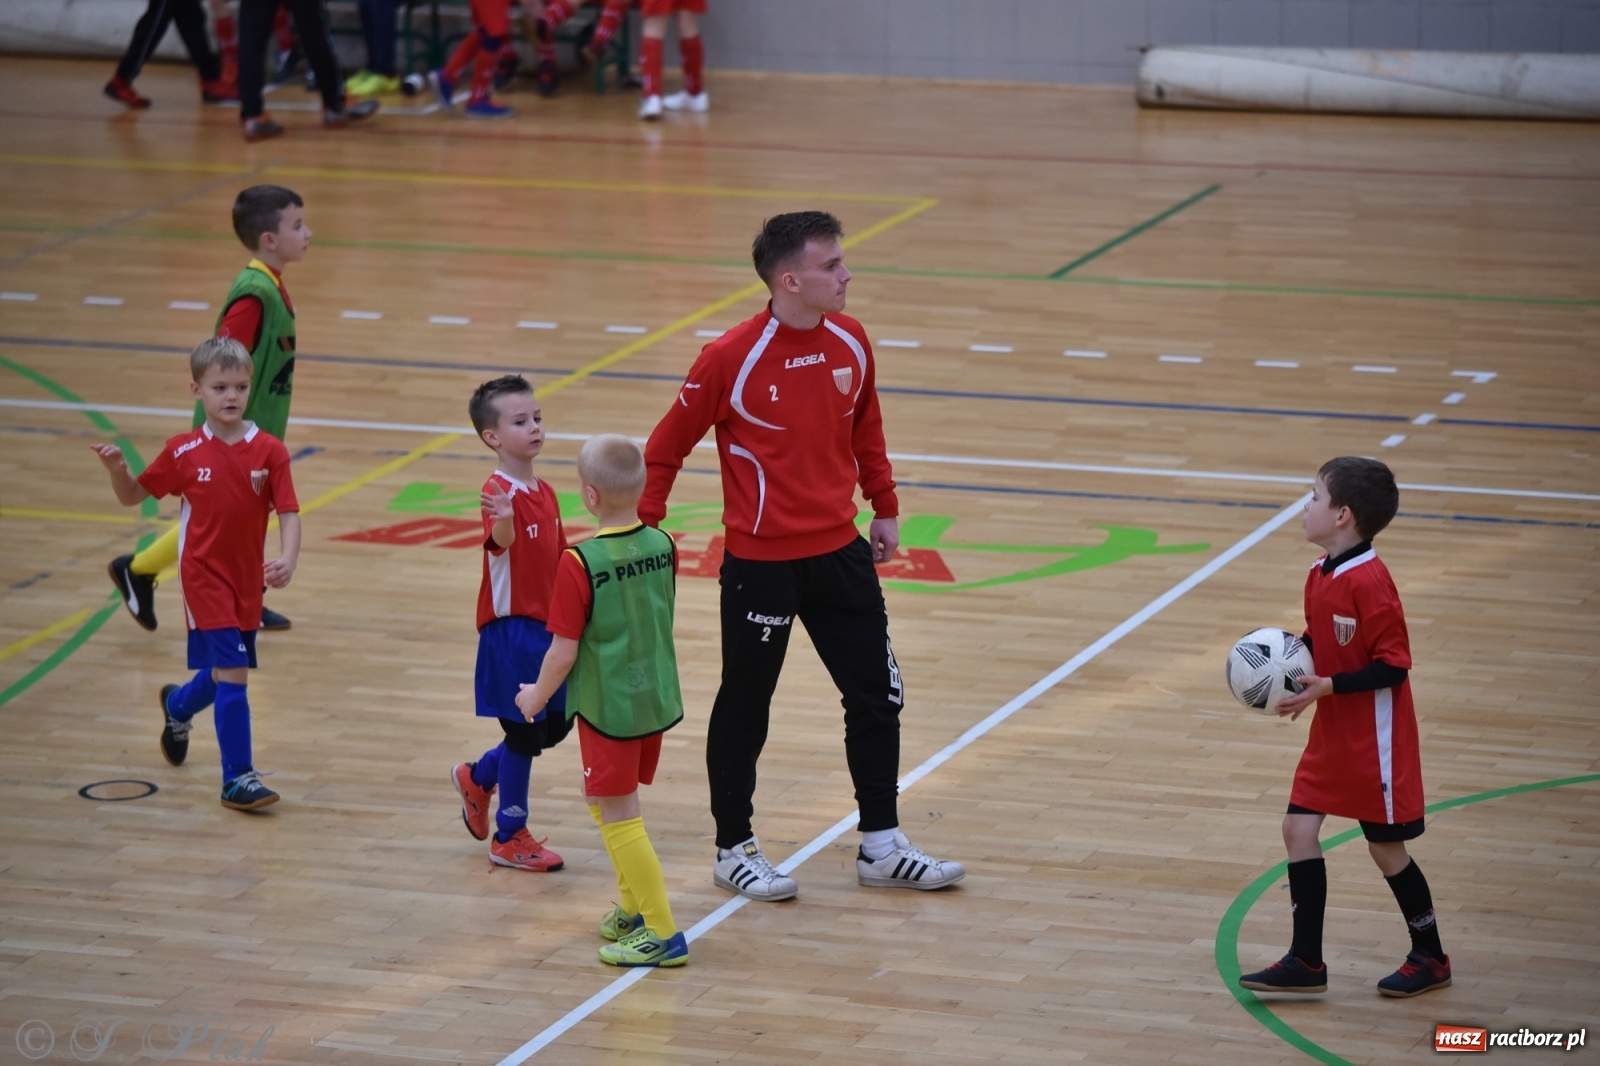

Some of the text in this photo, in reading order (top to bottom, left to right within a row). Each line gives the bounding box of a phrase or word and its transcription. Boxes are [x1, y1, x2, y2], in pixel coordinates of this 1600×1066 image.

[785, 353, 826, 369] LEGEA
[769, 385, 779, 402] 2
[173, 437, 204, 459] LEGEA
[197, 467, 212, 482] 22
[526, 523, 539, 539] 17
[615, 551, 674, 582] PATRICK
[746, 611, 791, 626] LEGEA
[761, 626, 771, 642] 2
